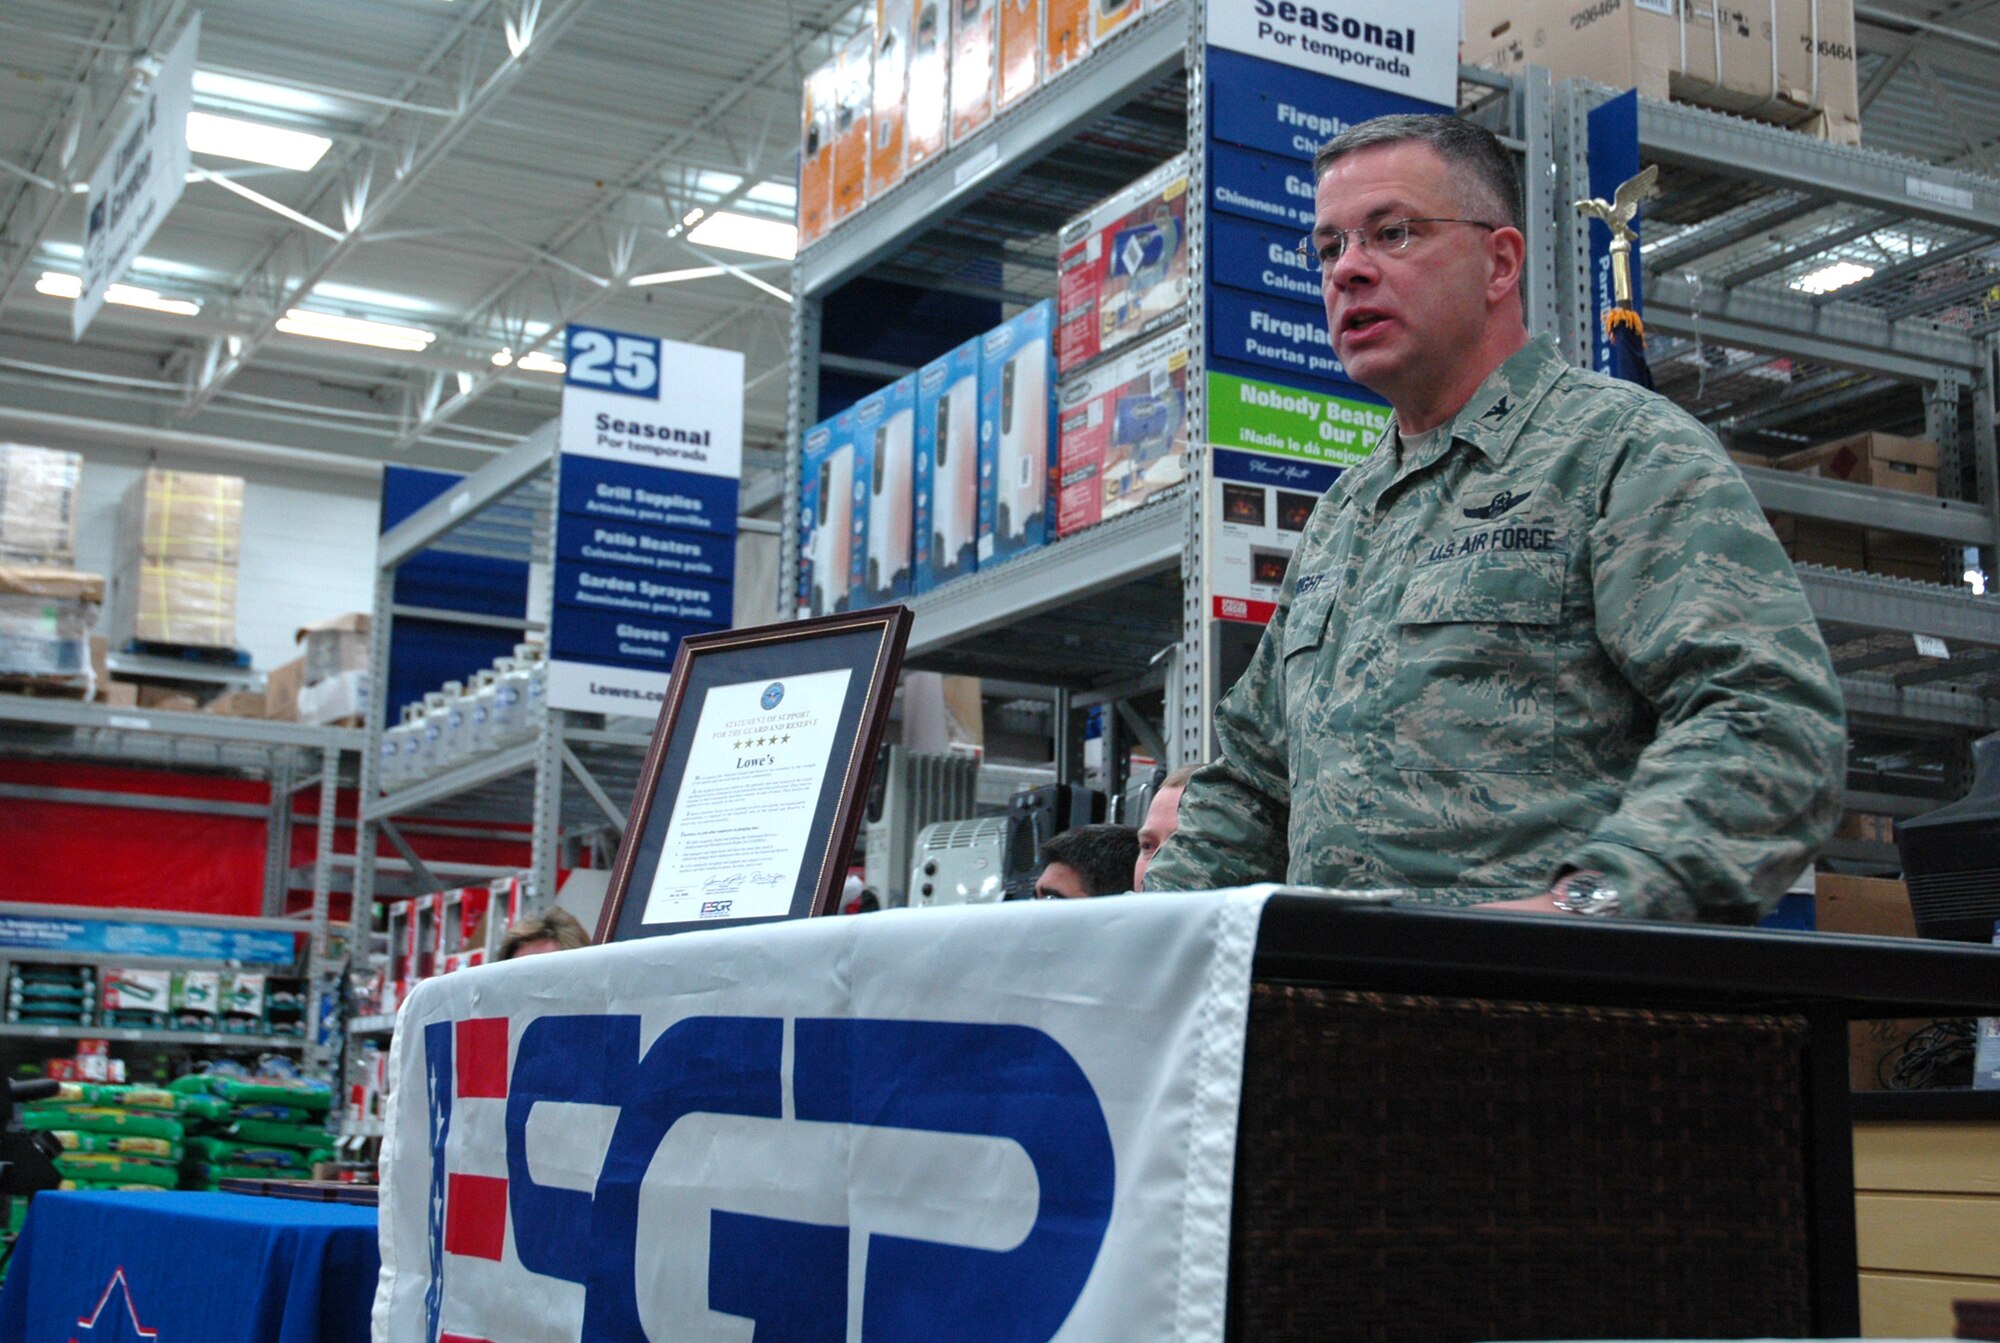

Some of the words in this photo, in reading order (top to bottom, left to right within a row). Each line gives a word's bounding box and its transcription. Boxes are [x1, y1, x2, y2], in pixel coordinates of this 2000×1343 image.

[1254, 0, 1415, 54] Seasonal
[1258, 21, 1295, 47] Por
[1302, 34, 1410, 77] temporada
[1801, 35, 1852, 60] 26464
[1277, 102, 1351, 137] Firepla
[1215, 186, 1286, 217] Chimeneas
[1288, 208, 1297, 219] a
[1262, 270, 1322, 296] Calenta
[570, 331, 657, 390] 25
[1246, 338, 1305, 364] Puertas
[1308, 355, 1343, 373] para
[1240, 384, 1320, 421] Nobody
[1327, 402, 1386, 430] Beats
[596, 412, 710, 446] Seasonal
[1319, 421, 1356, 444] Our
[597, 434, 623, 449] Por
[628, 440, 708, 462] temporada
[596, 483, 632, 500] Grill
[635, 489, 702, 511] Supplies
[595, 529, 637, 547] Patio
[640, 536, 701, 556] Heaters
[1429, 542, 1455, 560] U.S.
[1459, 532, 1489, 555] AIR
[1491, 528, 1555, 550] FORCE
[579, 572, 636, 592] Garden
[639, 580, 710, 603] Sprayers
[617, 623, 670, 642] Gloves
[590, 682, 665, 701] Lowes.co
[712, 732, 726, 740] FOR
[743, 725, 769, 735] GUARD
[770, 723, 785, 731] AND
[786, 718, 819, 730] RESERVE
[725, 716, 766, 729] STATEMENT
[767, 714, 777, 723] OF
[779, 710, 811, 721] SUPPORT
[736, 754, 775, 769] Lowe's
